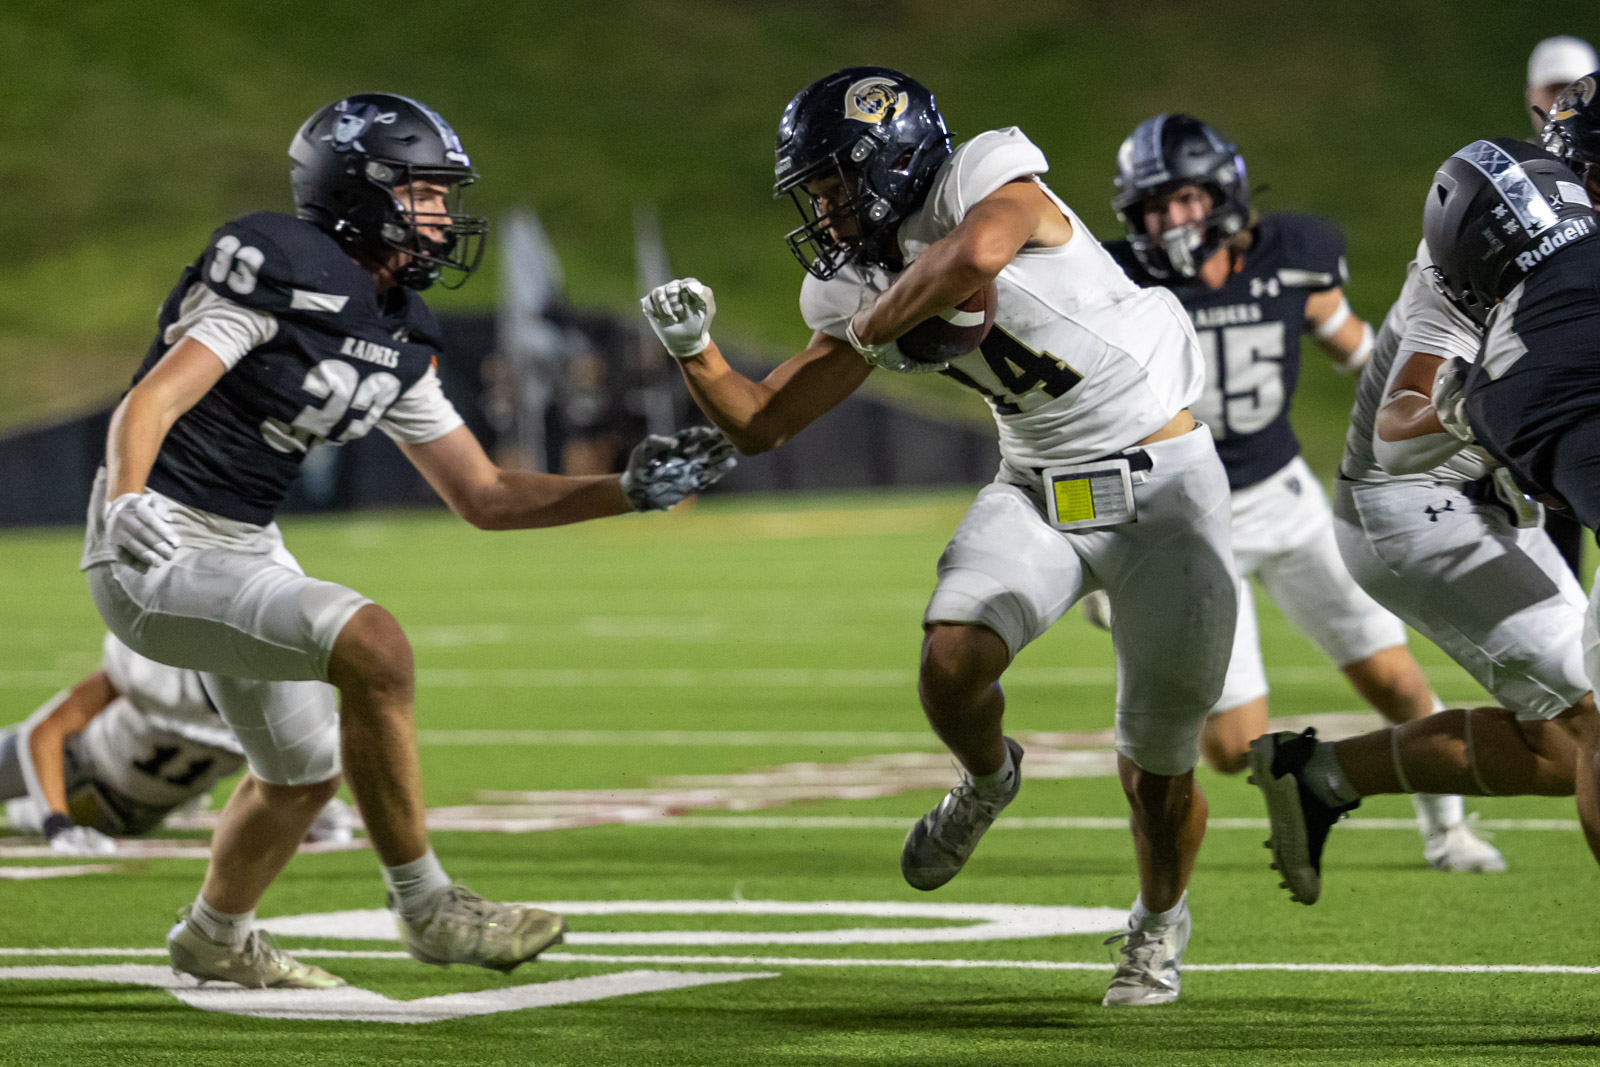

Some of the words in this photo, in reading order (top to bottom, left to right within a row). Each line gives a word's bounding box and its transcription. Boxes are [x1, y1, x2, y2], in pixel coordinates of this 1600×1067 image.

[1188, 303, 1262, 327] AIDERS
[340, 337, 400, 369] RAIDERS
[1190, 321, 1286, 440] 15
[133, 745, 214, 787] 11
